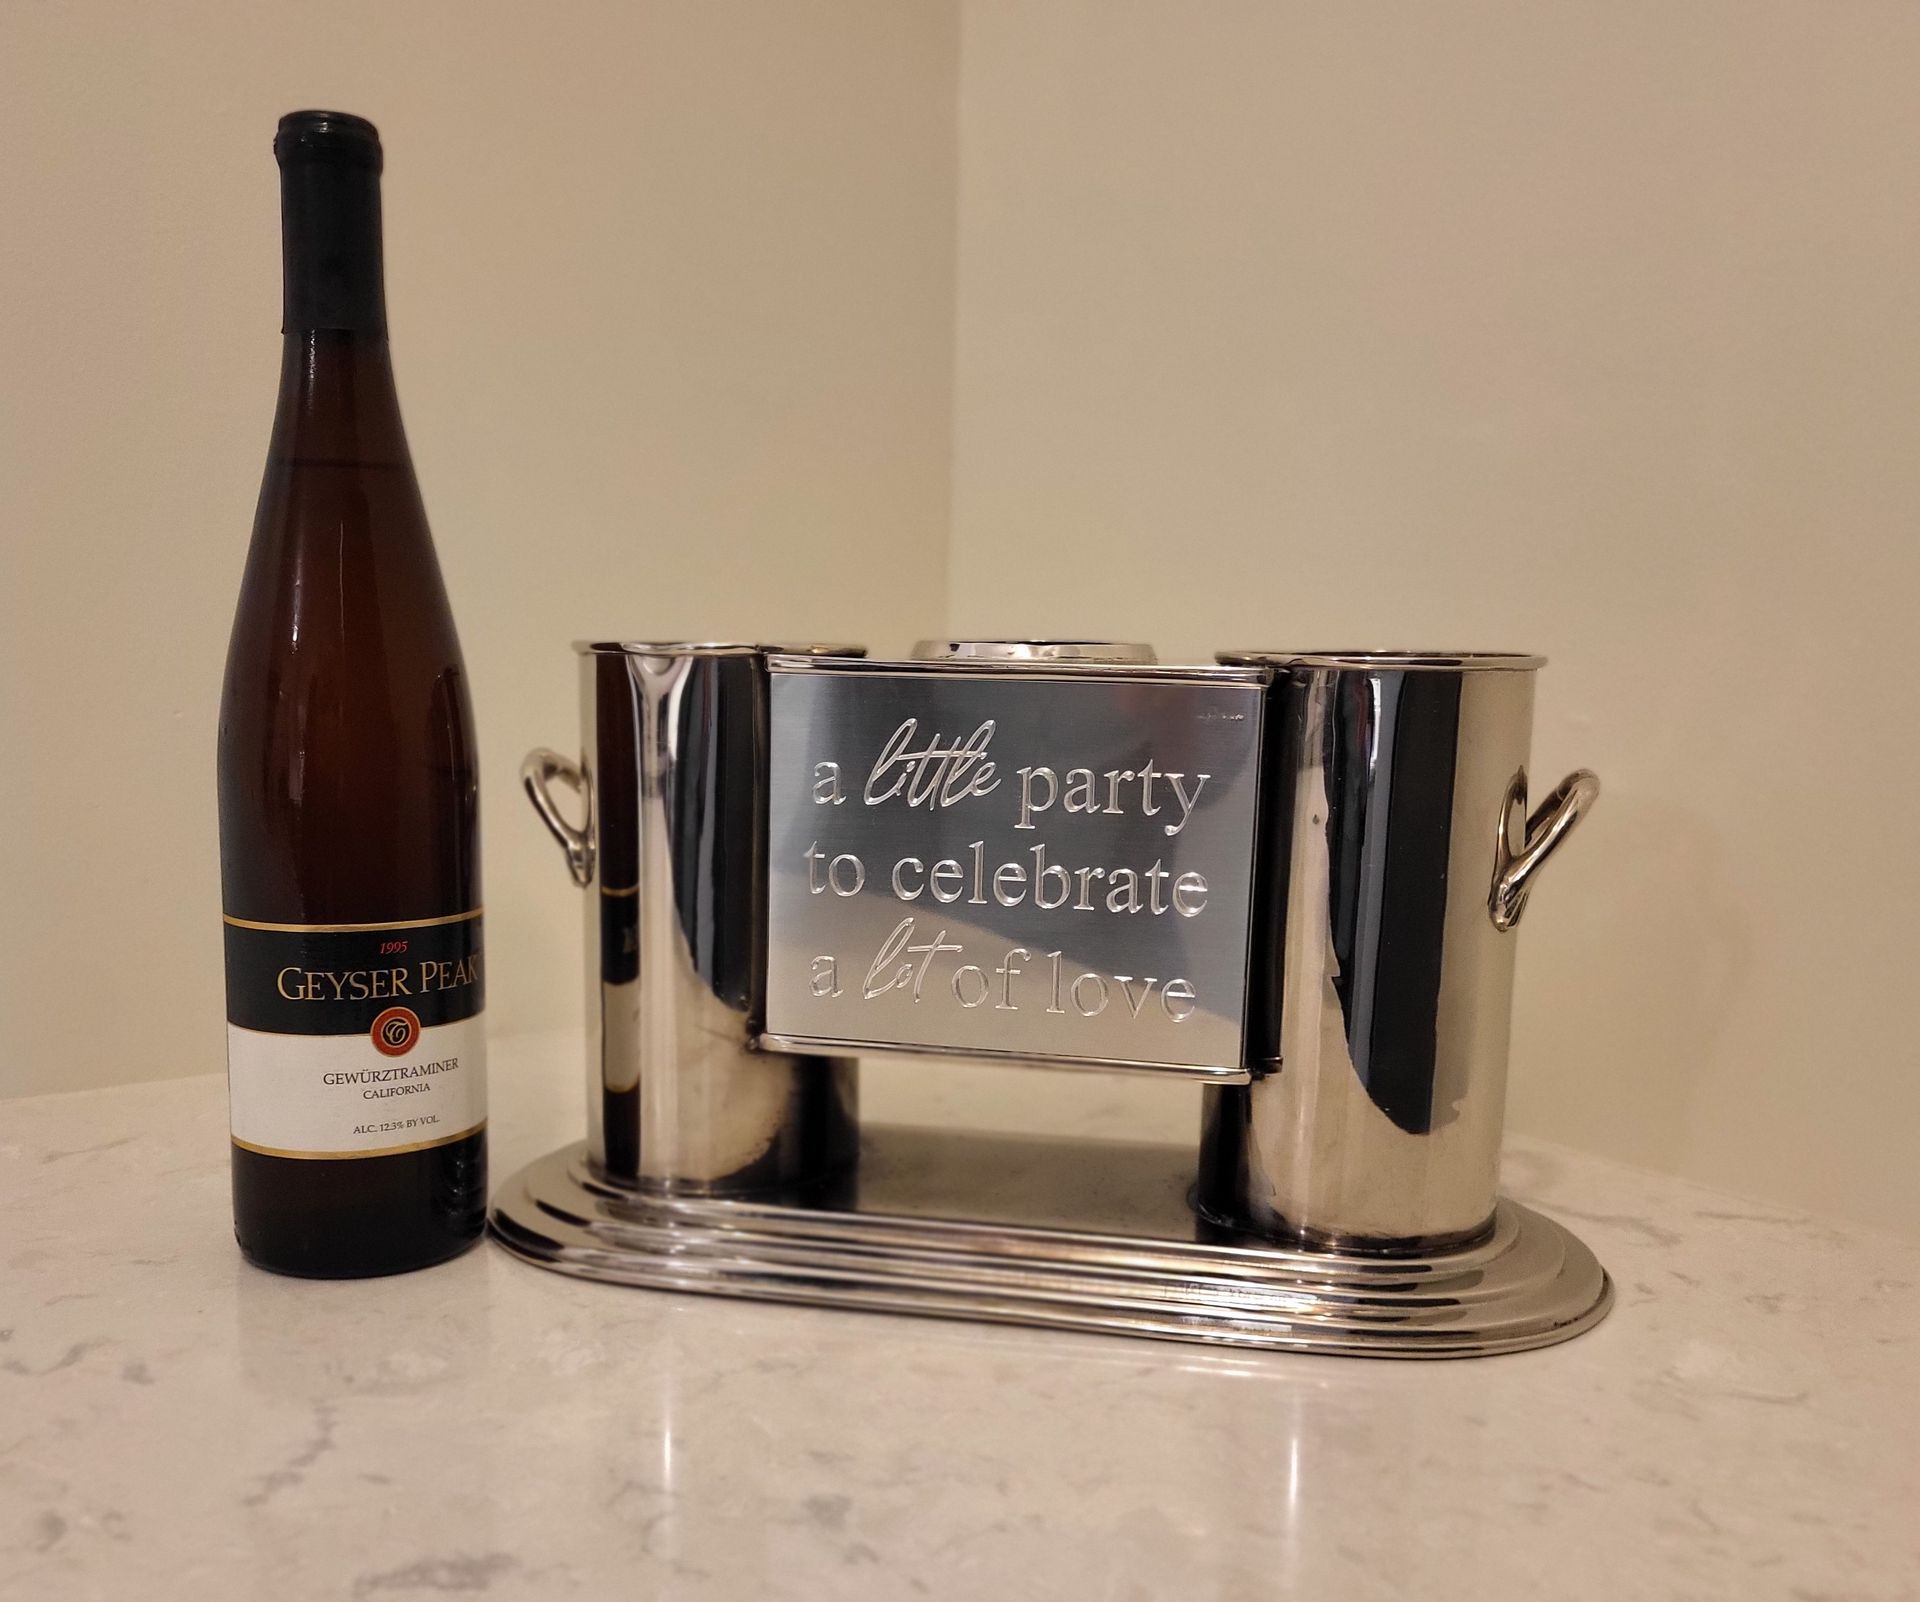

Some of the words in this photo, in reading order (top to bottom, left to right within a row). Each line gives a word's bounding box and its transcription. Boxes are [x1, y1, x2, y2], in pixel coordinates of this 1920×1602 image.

[812, 761, 846, 806] a
[864, 717, 1001, 811] little
[1013, 758, 1210, 836] party
[803, 840, 866, 897] to
[891, 840, 1208, 918] celebrate
[380, 940, 409, 955] 1995
[277, 967, 413, 1000] GEYSER
[809, 954, 843, 998] a
[862, 916, 963, 1003] lot
[951, 947, 1032, 1010] of
[1045, 949, 1197, 1023] love
[323, 1057, 459, 1085] GEWÜRZTRAMINER
[362, 1083, 431, 1100] CALIFORNIA
[353, 1124, 377, 1135] ALC.
[380, 1121, 404, 1132] 12.3%
[406, 1119, 418, 1128] BY
